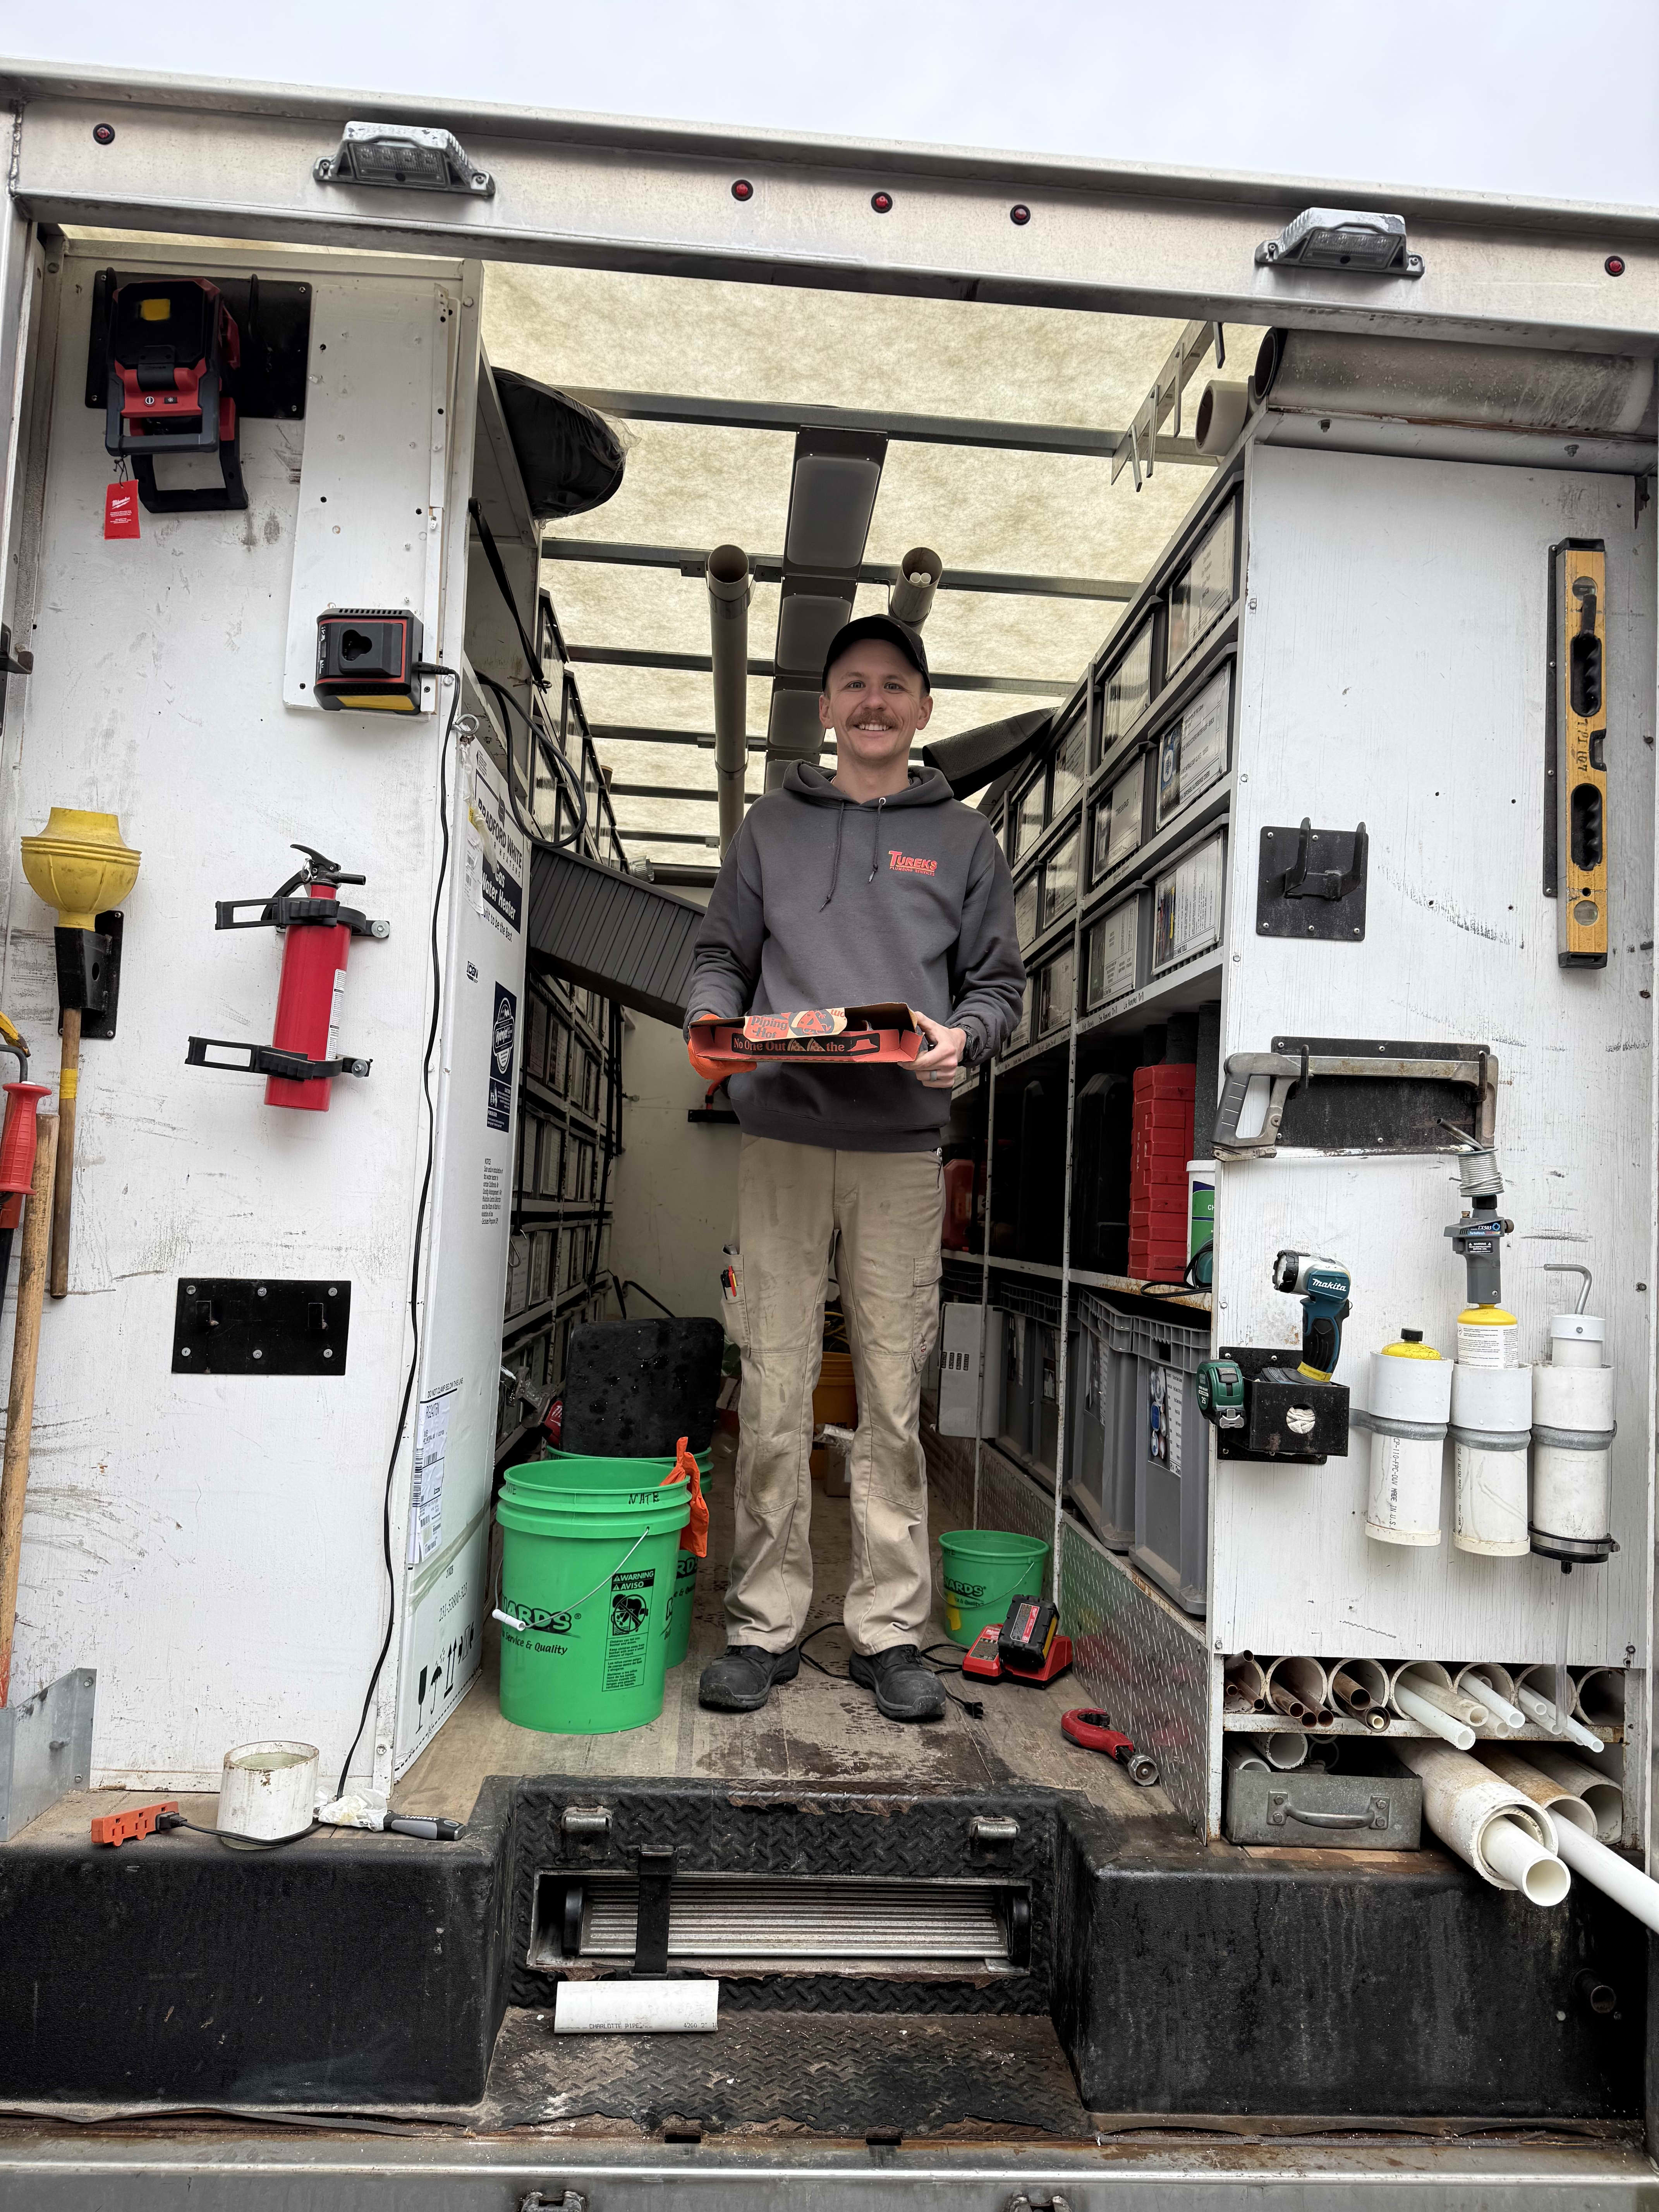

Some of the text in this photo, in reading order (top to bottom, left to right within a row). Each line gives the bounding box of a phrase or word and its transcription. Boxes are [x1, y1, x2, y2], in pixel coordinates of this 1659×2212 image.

[508, 834, 522, 869] WHITE
[495, 864, 505, 888] Gas
[482, 872, 516, 920] Water Heater
[491, 913, 495, 925] to
[495, 916, 500, 930] be
[734, 1038, 845, 1052] No One Out the
[629, 1491, 660, 1505] NATE
[620, 1571, 654, 1581] WARNING
[620, 1581, 644, 1590] AVISO
[526, 1640, 532, 1650] &
[535, 1642, 568, 1656] Quality
